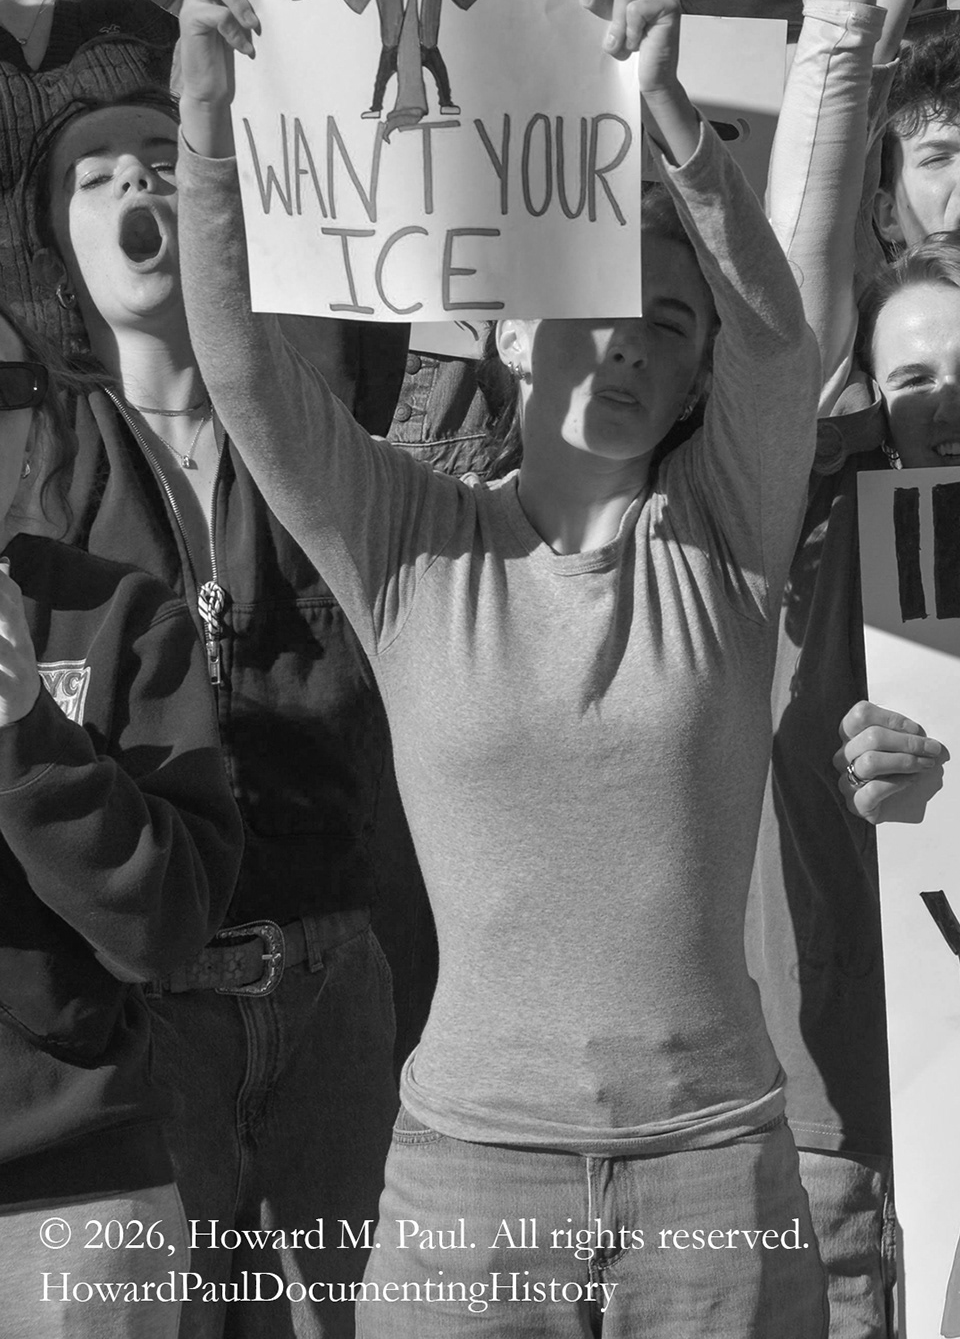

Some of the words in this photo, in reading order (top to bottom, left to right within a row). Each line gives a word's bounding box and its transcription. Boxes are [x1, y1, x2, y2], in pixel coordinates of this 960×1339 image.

[243, 114, 461, 223] WANT
[473, 113, 633, 227] YOUR
[321, 226, 506, 315] ICE
